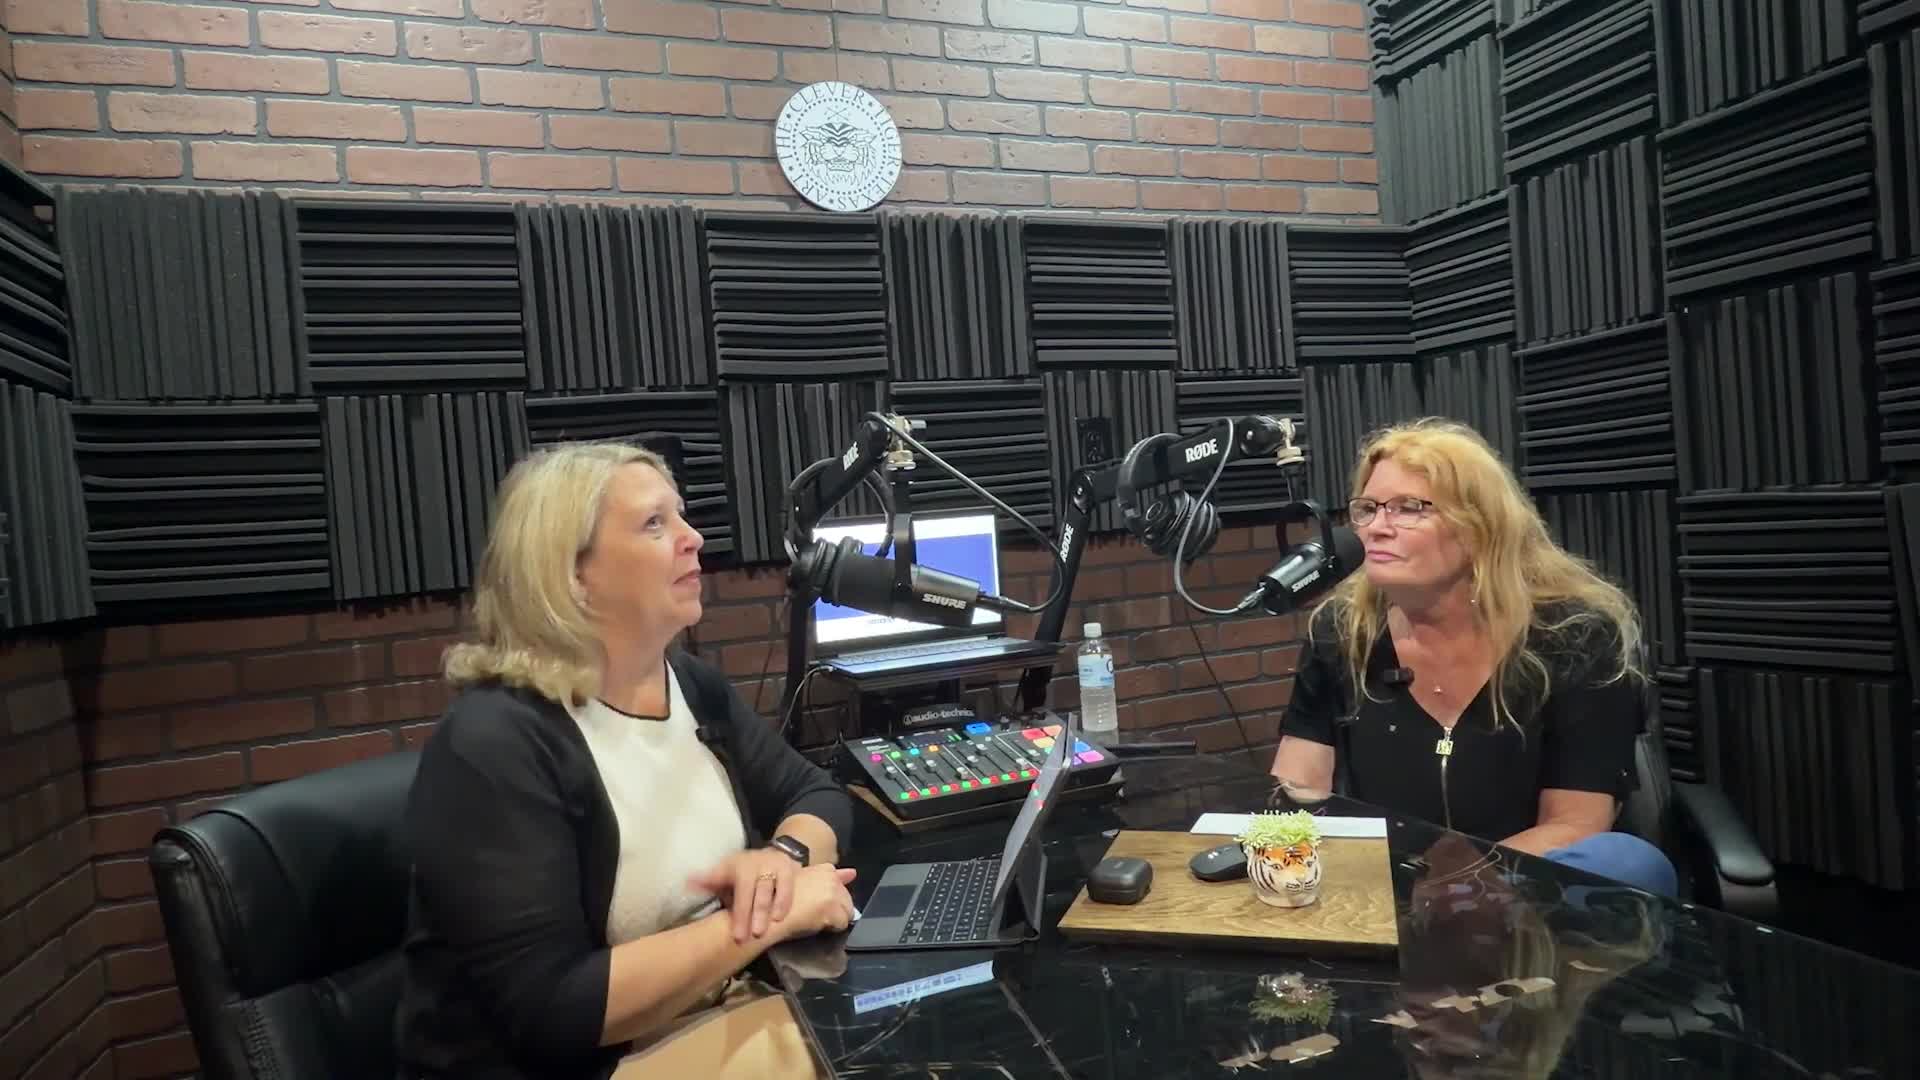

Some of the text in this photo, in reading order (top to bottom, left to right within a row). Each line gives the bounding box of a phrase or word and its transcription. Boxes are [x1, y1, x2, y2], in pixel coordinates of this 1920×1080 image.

[776, 81, 902, 210] THE CLEVER TIGER TEXAS ART
[1184, 438, 1219, 463] RØDE
[1291, 569, 1321, 593] SHURE
[921, 592, 968, 610] SHURE
